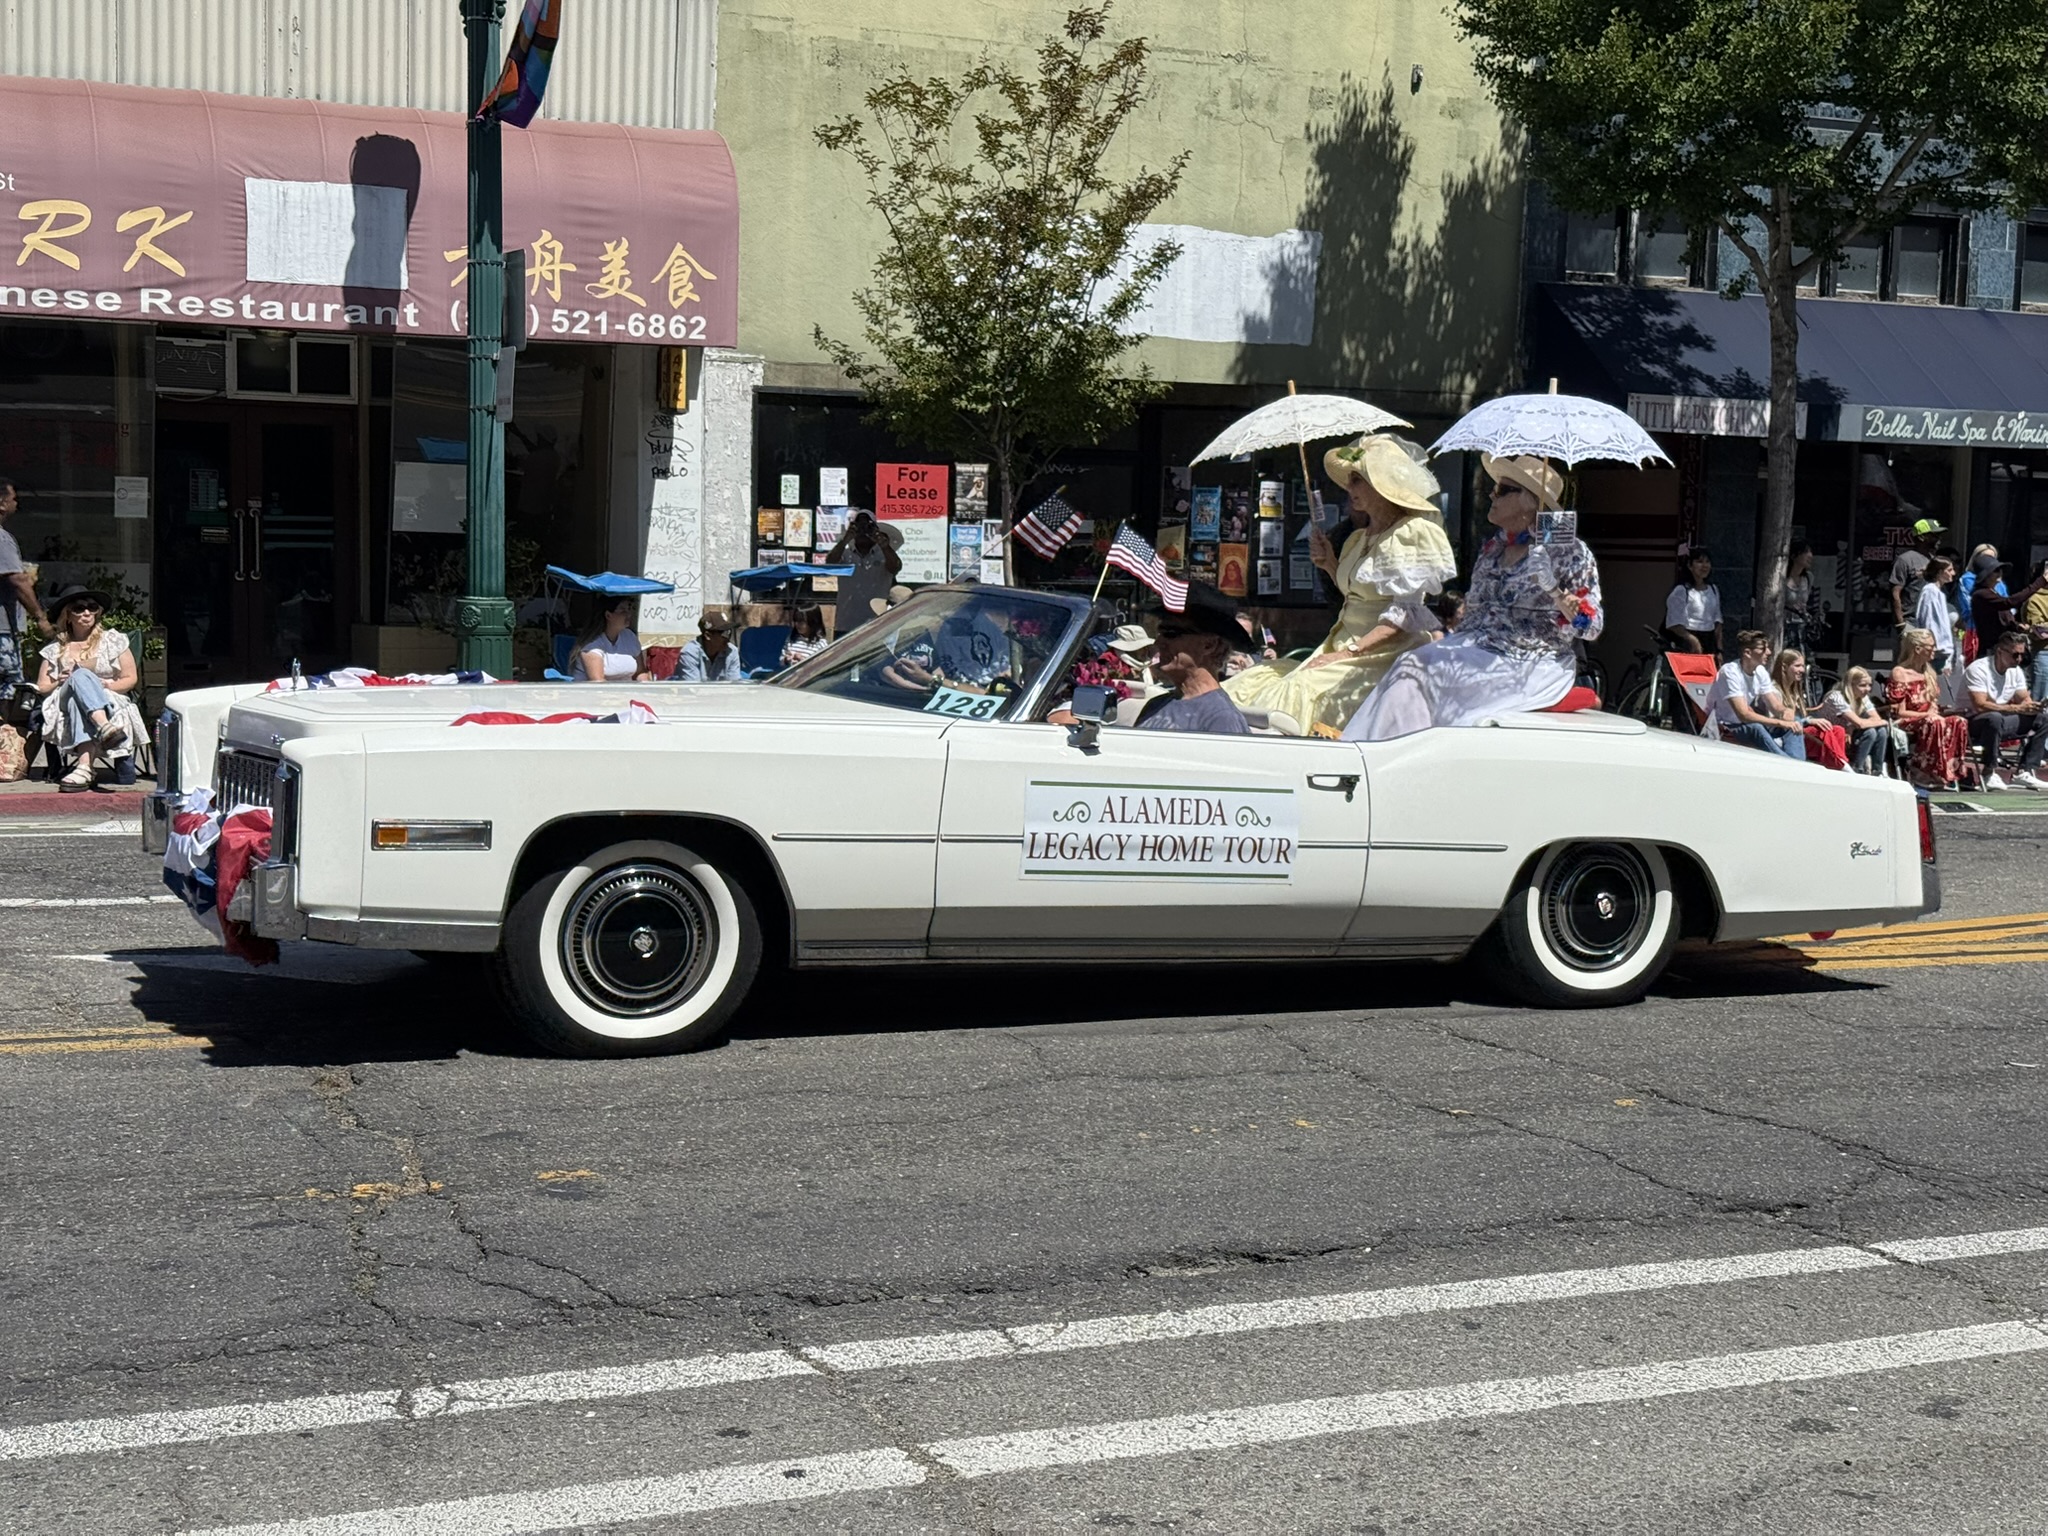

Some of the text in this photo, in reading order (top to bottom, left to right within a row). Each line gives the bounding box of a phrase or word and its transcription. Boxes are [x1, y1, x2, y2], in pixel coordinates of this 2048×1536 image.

[140, 288, 419, 328] Restaurant
[551, 308, 707, 340] 521-6862
[1635, 400, 1688, 429] LITTLE
[1865, 409, 1914, 438] Bella
[1915, 411, 1958, 441] Nail
[1958, 415, 1988, 446] Spa
[1990, 415, 2006, 442] &
[897, 466, 928, 482] For
[886, 484, 938, 500] Lease
[1883, 526, 1916, 546] TK
[929, 691, 996, 718] 128
[1098, 795, 1228, 827] ALAMEDA
[1026, 831, 1292, 864] LEGACY HOME TOUR
